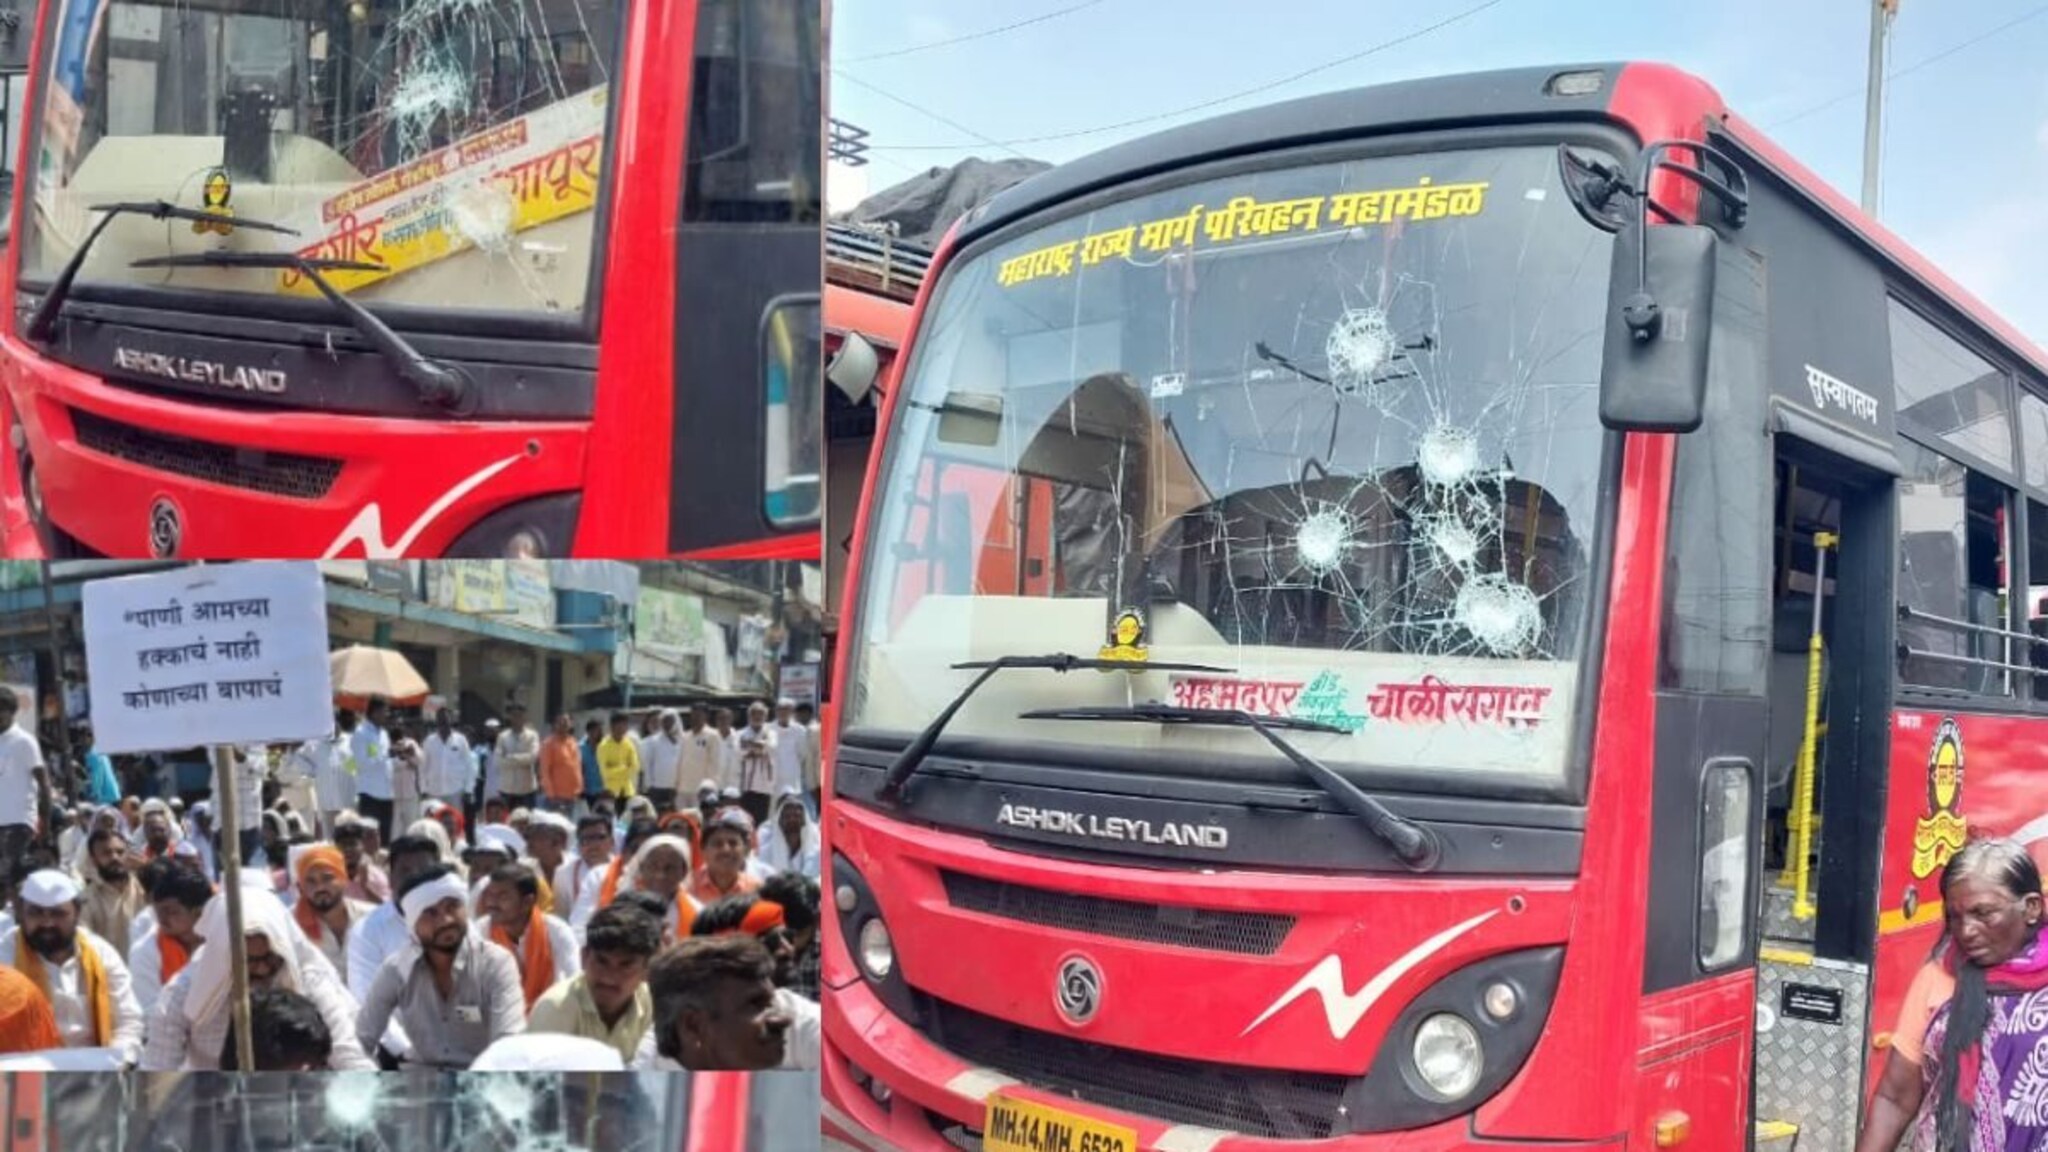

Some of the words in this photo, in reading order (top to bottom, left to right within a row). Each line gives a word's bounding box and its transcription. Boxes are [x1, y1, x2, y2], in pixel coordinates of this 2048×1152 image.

[998, 240, 1079, 286] महाराष्ट्र
[1080, 226, 1137, 263] राज्य
[1139, 204, 1204, 251] मार्ग
[1203, 196, 1325, 242] परिवहन
[1328, 176, 1489, 226] महामंडळ
[113, 347, 176, 379] ASHOK
[179, 358, 287, 393] LEYLAND
[1804, 363, 1879, 425] सुस्वागतम
[193, 598, 271, 622] आमच्या
[137, 636, 208, 671] हक्काचं
[214, 631, 261, 661] नाही
[122, 682, 208, 710] कोणाच्या
[216, 671, 283, 701] बापाचं
[996, 803, 1086, 836] ASHOK
[1089, 815, 1229, 849] LEYLAND
